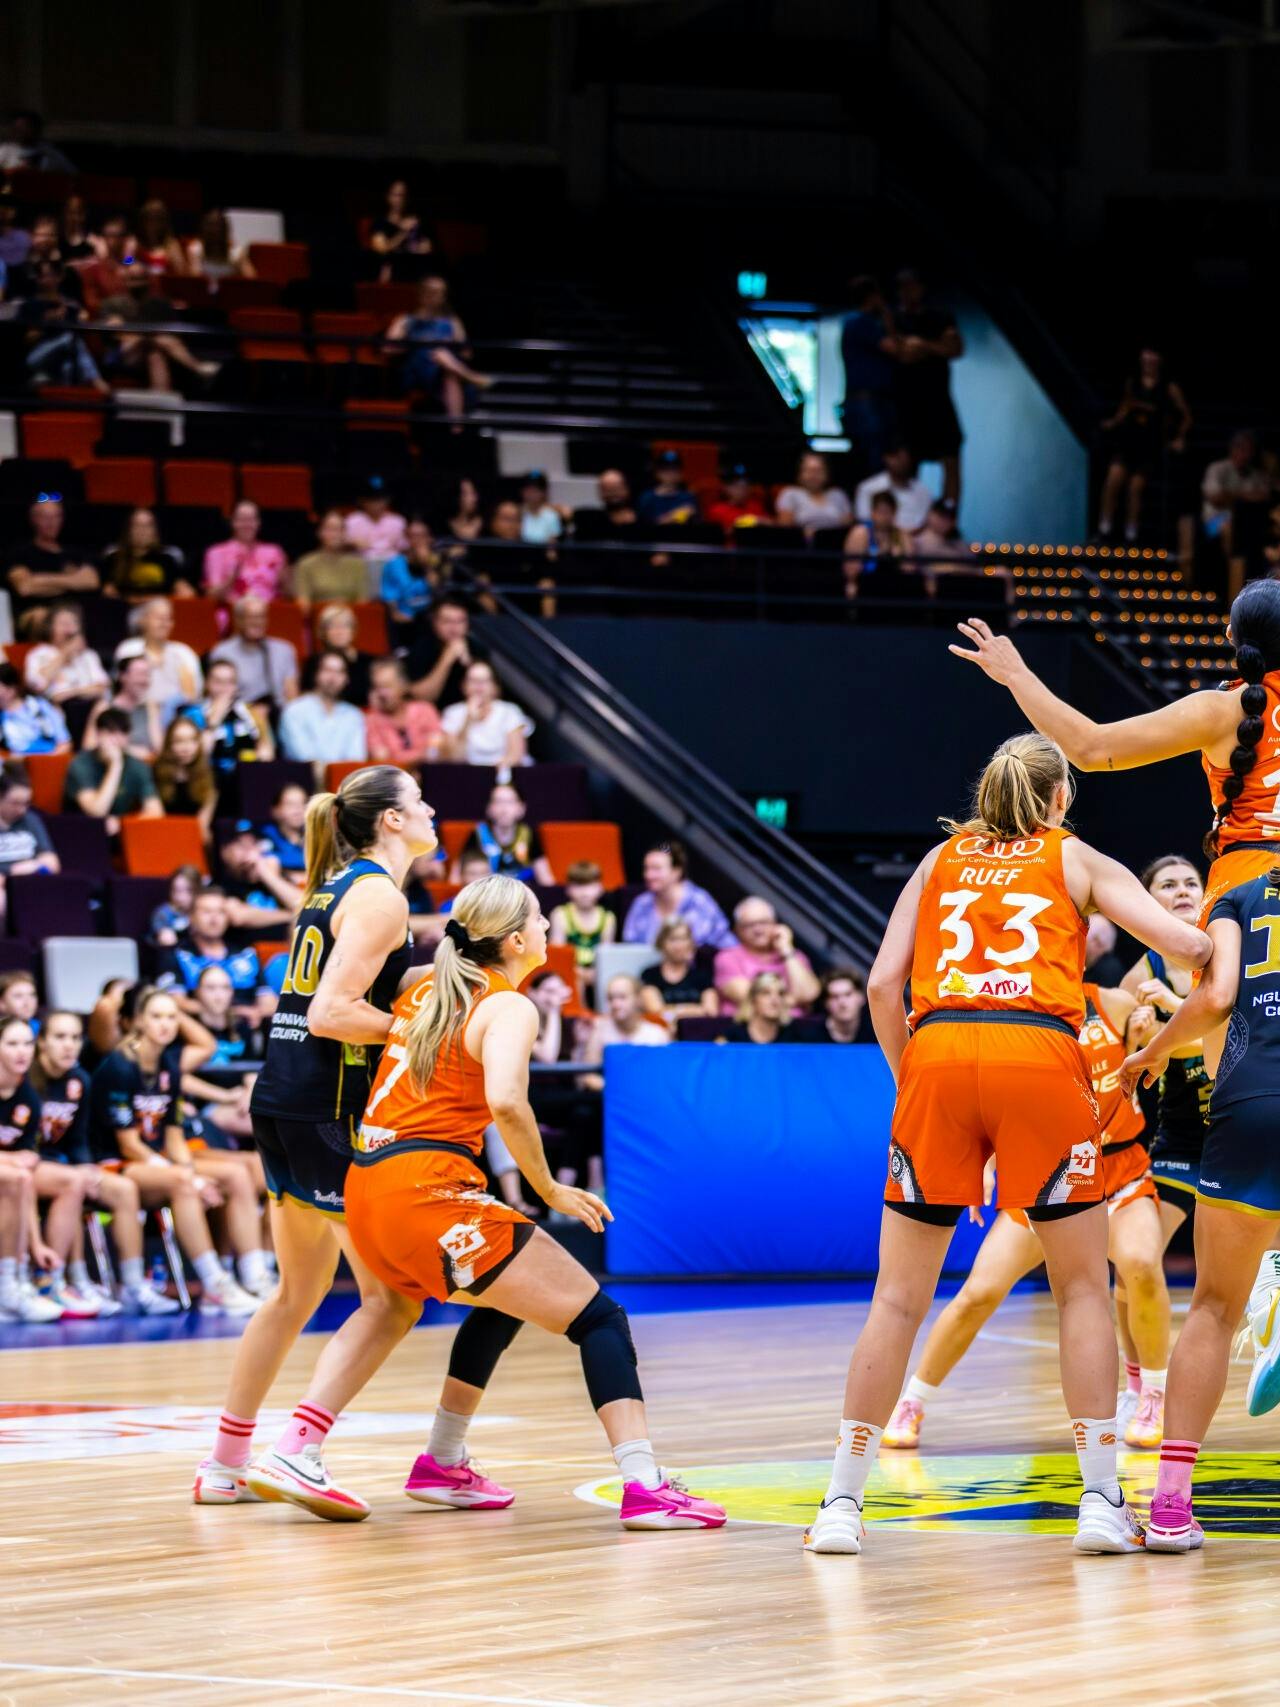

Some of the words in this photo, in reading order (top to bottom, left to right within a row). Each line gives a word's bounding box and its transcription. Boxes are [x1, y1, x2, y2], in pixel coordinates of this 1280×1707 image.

[946, 856, 966, 864] Audi
[967, 856, 999, 866] Centre
[1001, 856, 1047, 865] Townsville
[958, 866, 1023, 886] RUEF
[935, 889, 1054, 973] 33
[280, 923, 324, 997] 10
[979, 979, 1029, 995] Army
[365, 1043, 412, 1118] 7
